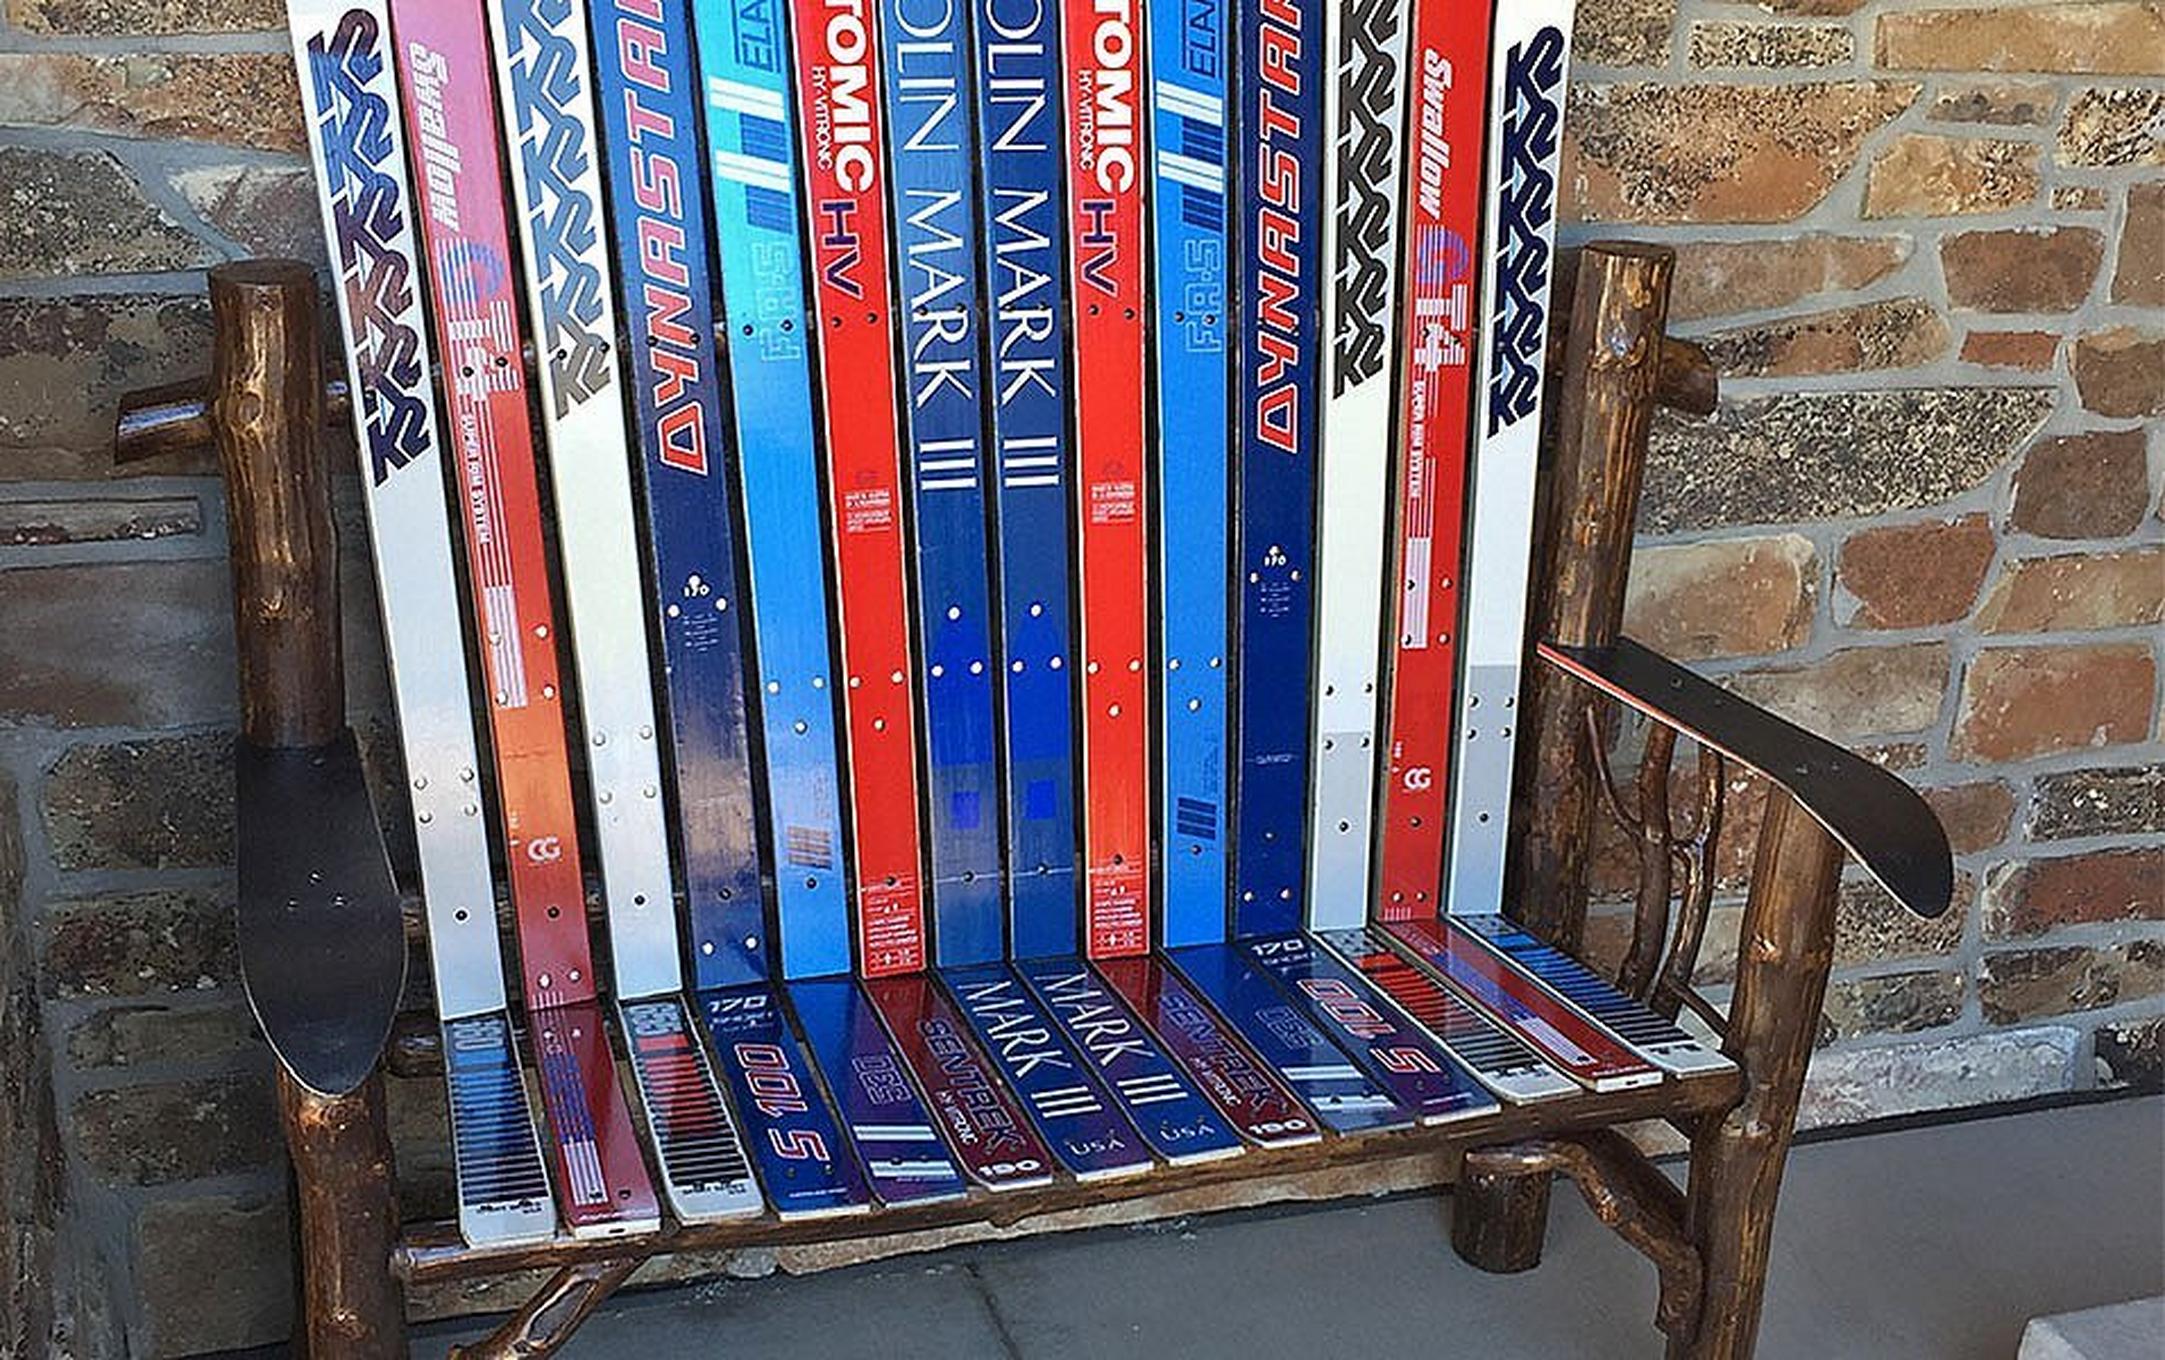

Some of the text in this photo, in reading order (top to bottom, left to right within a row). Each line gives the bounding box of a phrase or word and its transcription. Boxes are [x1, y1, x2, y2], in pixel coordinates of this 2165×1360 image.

[307, 8, 382, 116] K2
[1189, 0, 1215, 78] ELA
[1502, 26, 1564, 117] K2
[510, 36, 580, 136] K2
[1339, 51, 1396, 139] K2
[320, 93, 393, 197] K2
[409, 41, 461, 231] Swallow
[520, 115, 589, 212] K2
[1337, 123, 1392, 212] K2
[1420, 48, 1453, 219] Swallow
[1502, 99, 1558, 189] K2
[334, 173, 403, 271] K2
[531, 190, 596, 282] K2
[819, 200, 864, 299] HV
[895, 0, 977, 490] OLIN MARK III
[986, 0, 1059, 488] OLIN MARK III
[1082, 200, 1120, 295] HV
[1337, 191, 1390, 277] K2
[1499, 168, 1553, 256] K2
[344, 250, 412, 346] K2
[541, 262, 604, 352] K2
[1335, 258, 1387, 344] K2
[1495, 234, 1547, 320] K2
[355, 325, 421, 416] K2
[551, 333, 611, 421] K2
[1333, 325, 1384, 399] K2
[1491, 300, 1544, 380] K2
[366, 396, 430, 487] K2
[1487, 363, 1537, 438] K2
[1251, 938, 1304, 956] 170
[708, 995, 767, 1013] 170
[957, 980, 1072, 1078] MARK
[1031, 1086, 1102, 1118] III
[1033, 968, 1155, 1067] MARK
[1117, 1074, 1188, 1105] III
[1297, 978, 1396, 1039] 100
[734, 1043, 808, 1118] 100
[918, 1017, 1026, 1154] SENTREK
[1070, 1136, 1125, 1157] USA
[1160, 1123, 1216, 1142] USA
